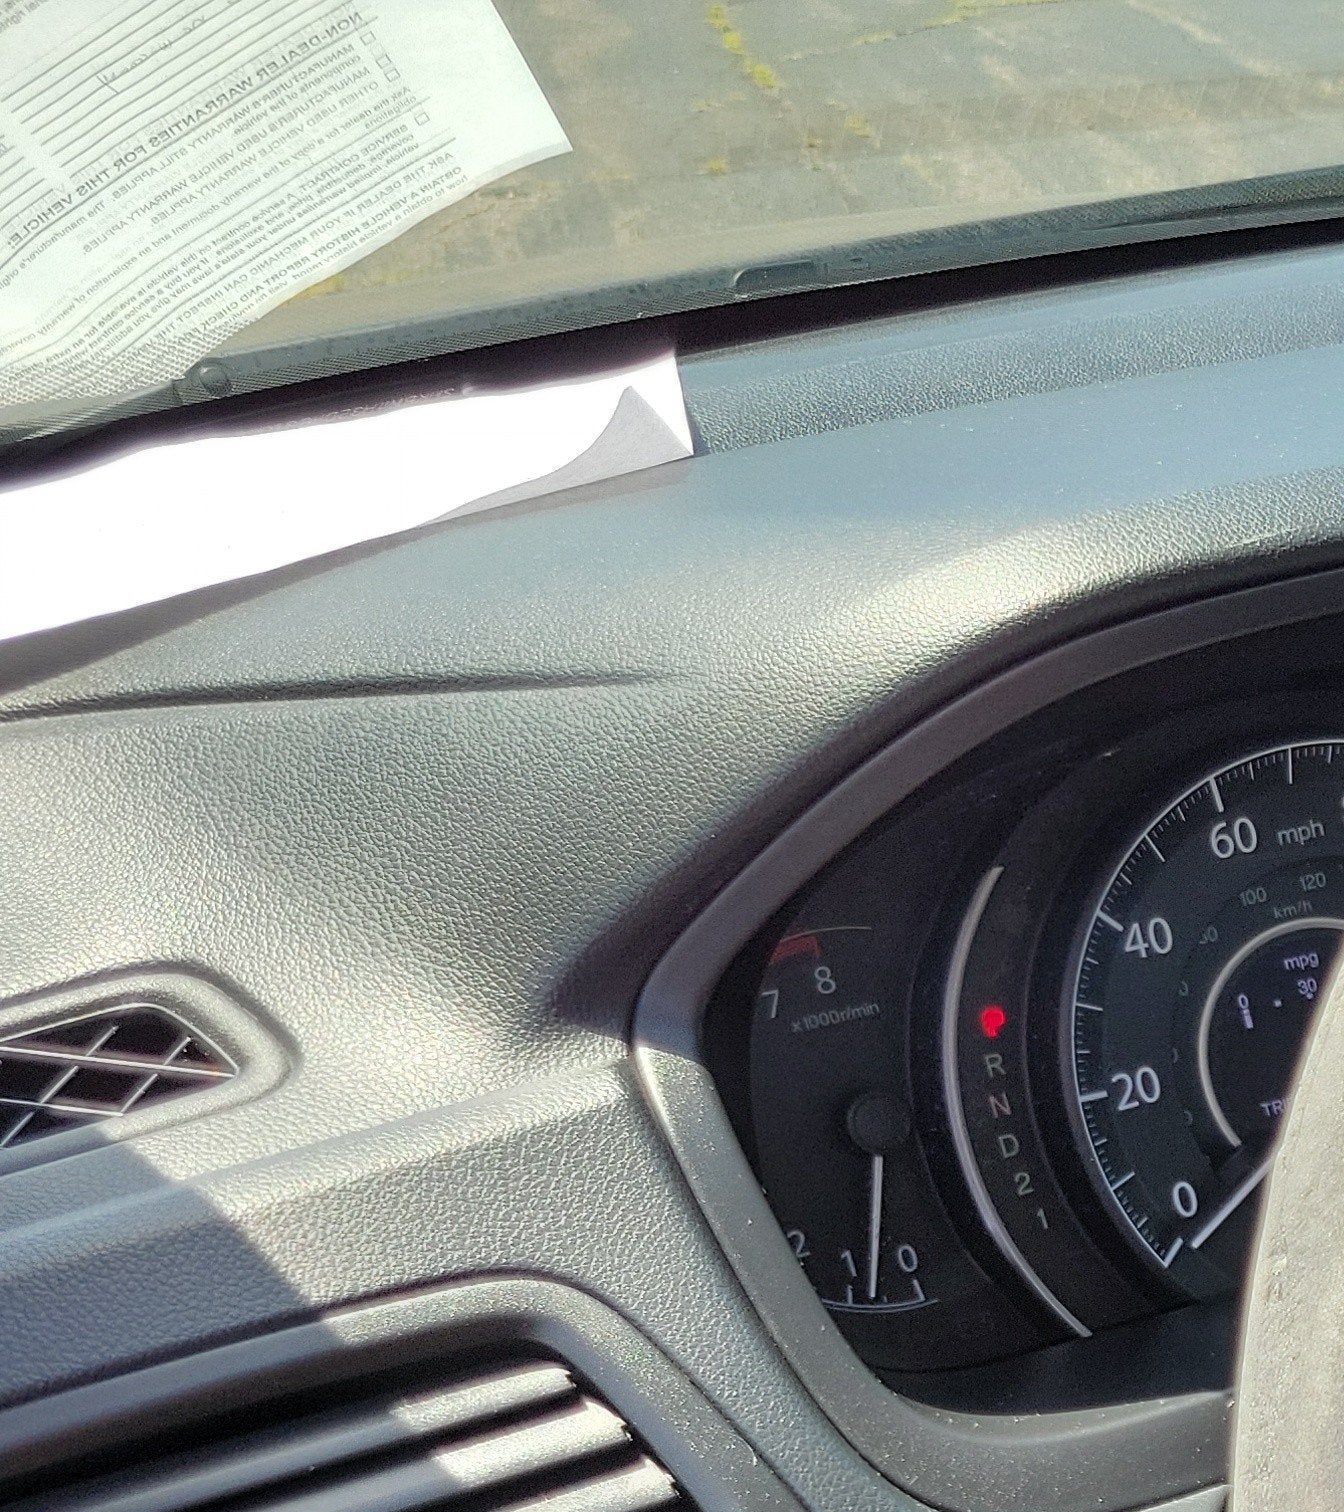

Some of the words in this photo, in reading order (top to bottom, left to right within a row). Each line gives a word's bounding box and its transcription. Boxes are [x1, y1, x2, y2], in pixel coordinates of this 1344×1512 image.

[1209, 816, 1259, 860] 60
[1277, 820, 1325, 848] mph
[1299, 872, 1327, 892] 120
[1239, 887, 1268, 906] 100
[1273, 900, 1314, 919] km/h
[1123, 916, 1174, 959] 40
[1283, 953, 1320, 971] mpg
[814, 966, 836, 994] 8
[1297, 977, 1318, 994] 30
[761, 989, 779, 1019] 7
[1238, 993, 1249, 1010] 0
[984, 1054, 1006, 1077] R
[1112, 1065, 1161, 1112] 20
[988, 1094, 1012, 1117] N
[999, 1134, 1020, 1158] D
[1015, 1172, 1033, 1196] 2
[1171, 1181, 1198, 1218] 0
[1036, 1208, 1049, 1230] 1
[786, 1230, 811, 1258] 2
[841, 1249, 857, 1277] 1
[898, 1244, 918, 1272] 0
